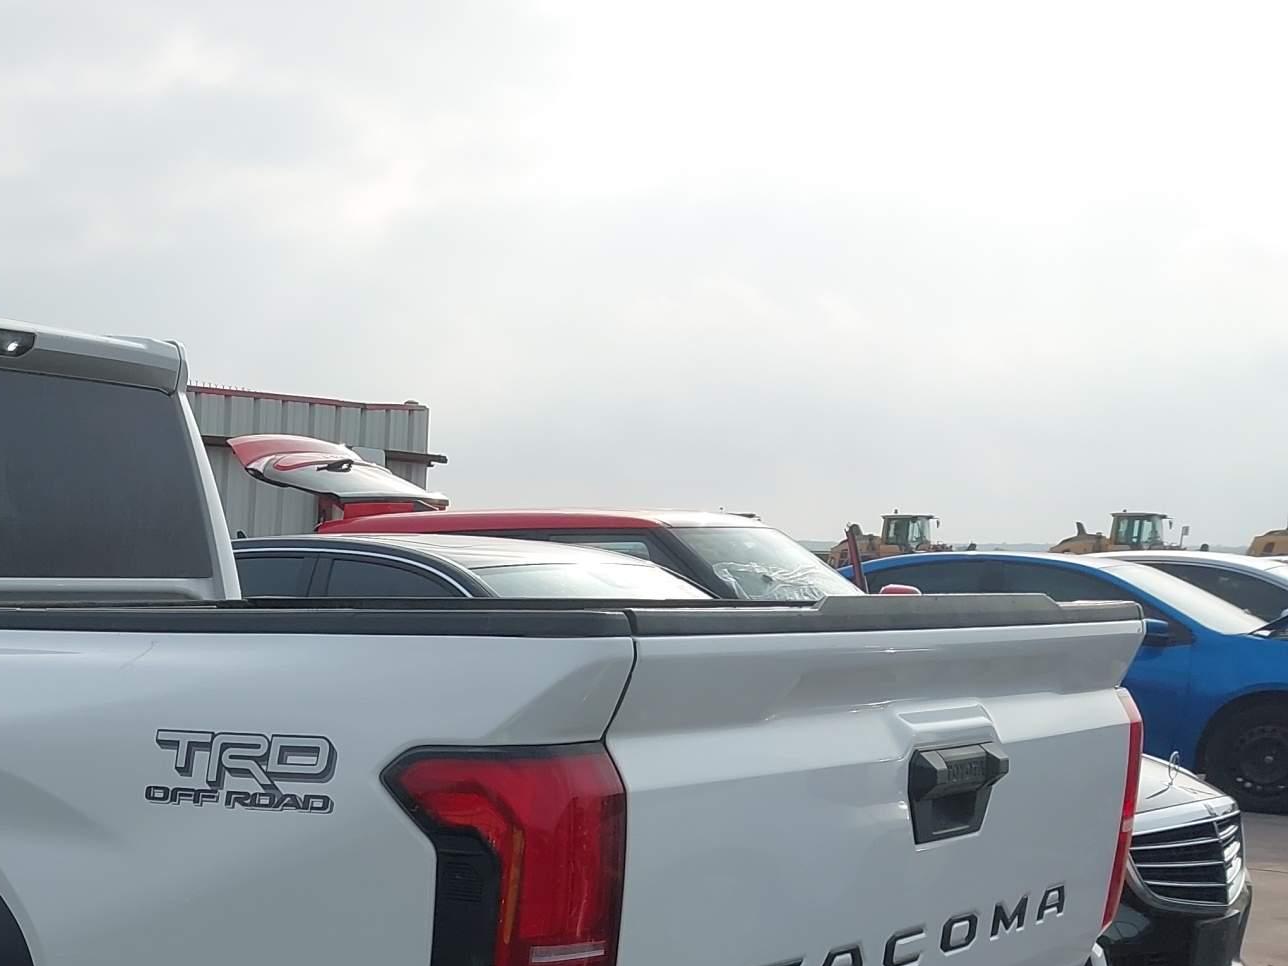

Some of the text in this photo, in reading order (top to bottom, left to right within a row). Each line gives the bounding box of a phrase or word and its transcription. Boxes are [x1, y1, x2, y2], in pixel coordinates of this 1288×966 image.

[156, 729, 338, 790] TRD
[145, 785, 335, 814] OFF ROAD
